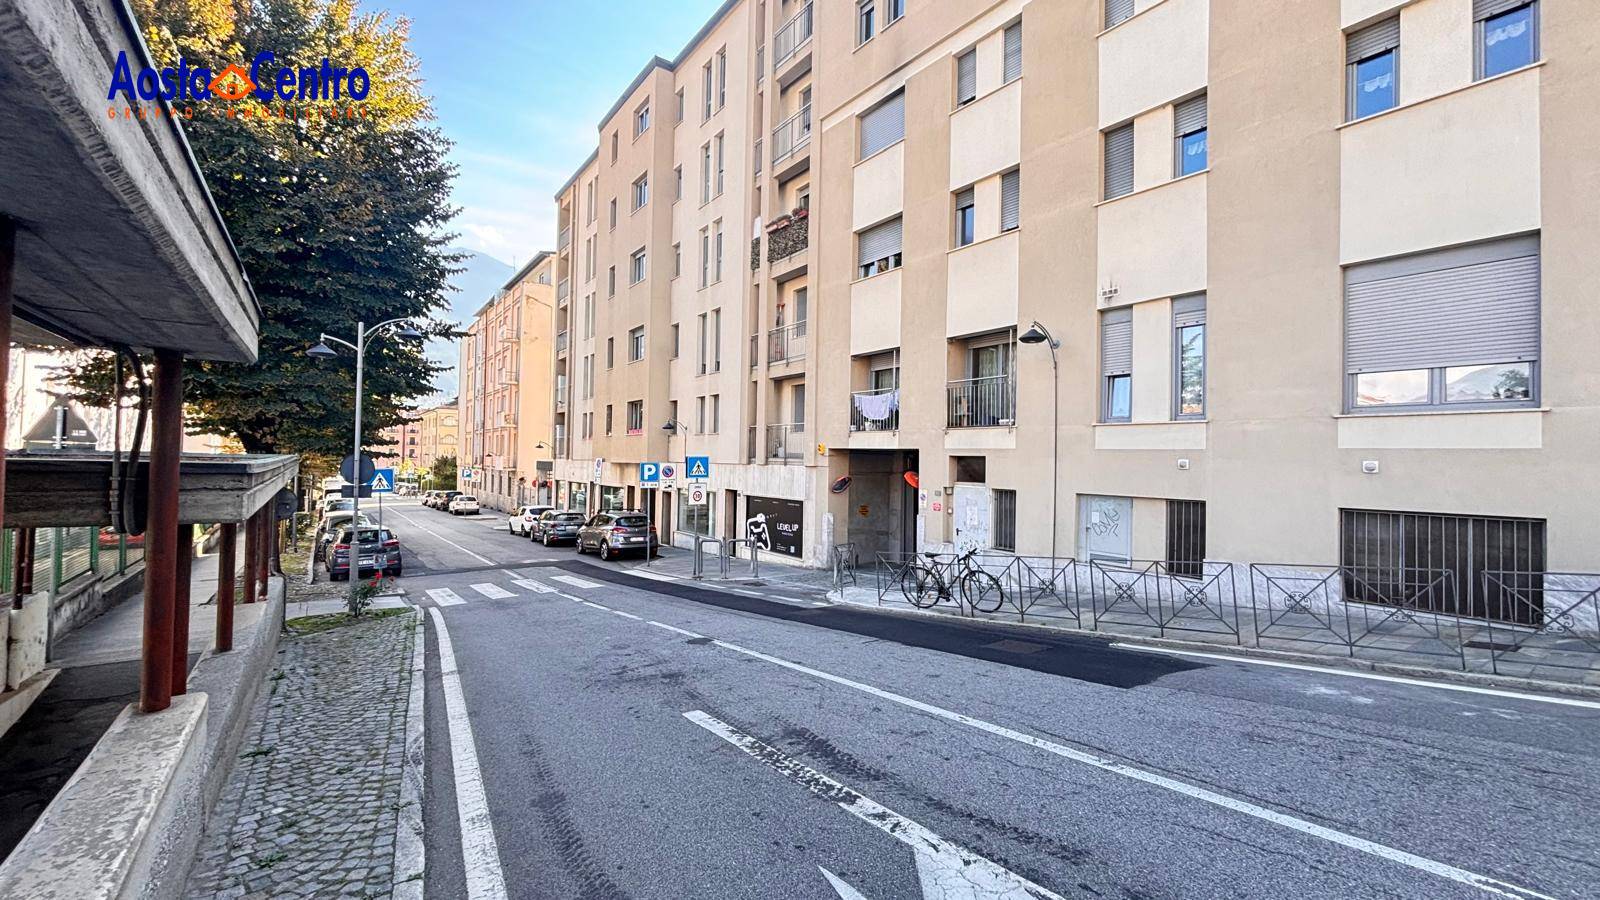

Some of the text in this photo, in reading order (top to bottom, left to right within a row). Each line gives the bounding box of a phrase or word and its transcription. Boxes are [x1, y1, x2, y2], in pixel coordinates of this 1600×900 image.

[643, 464, 656, 480] P
[776, 522, 799, 532] LEVEL UP
